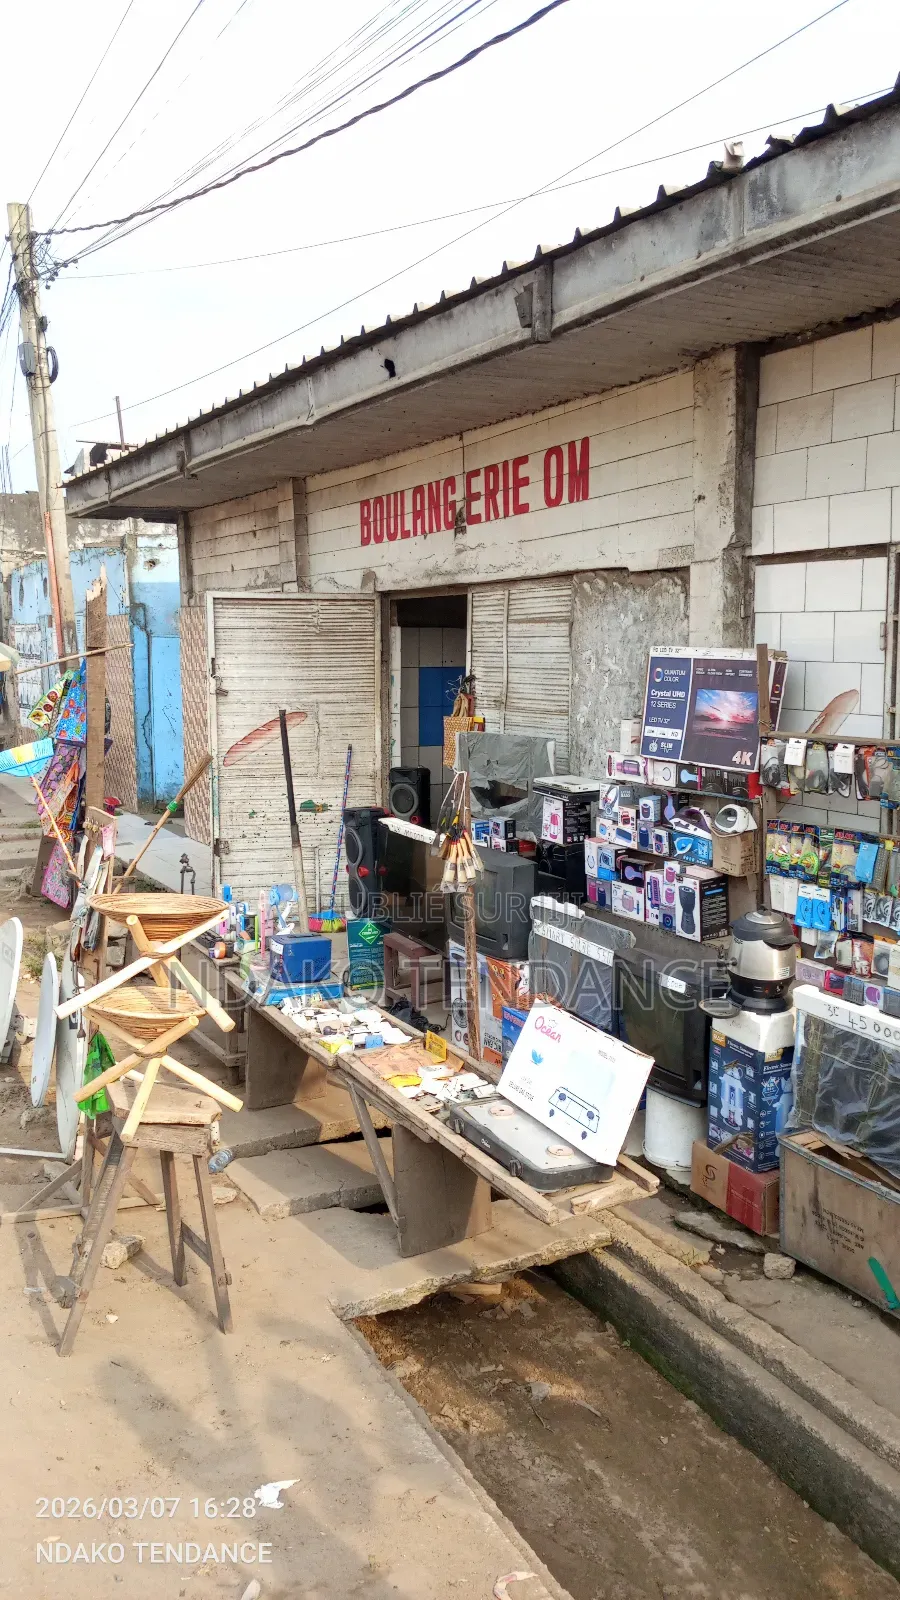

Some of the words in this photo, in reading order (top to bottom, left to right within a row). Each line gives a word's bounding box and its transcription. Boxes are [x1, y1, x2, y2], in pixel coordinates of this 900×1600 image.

[544, 436, 590, 508] OM
[651, 689, 671, 698] Crystal
[672, 690, 686, 699] UHD
[657, 701, 677, 709] SERIES
[732, 750, 754, 766] 4K
[533, 1015, 562, 1044] Ocean
